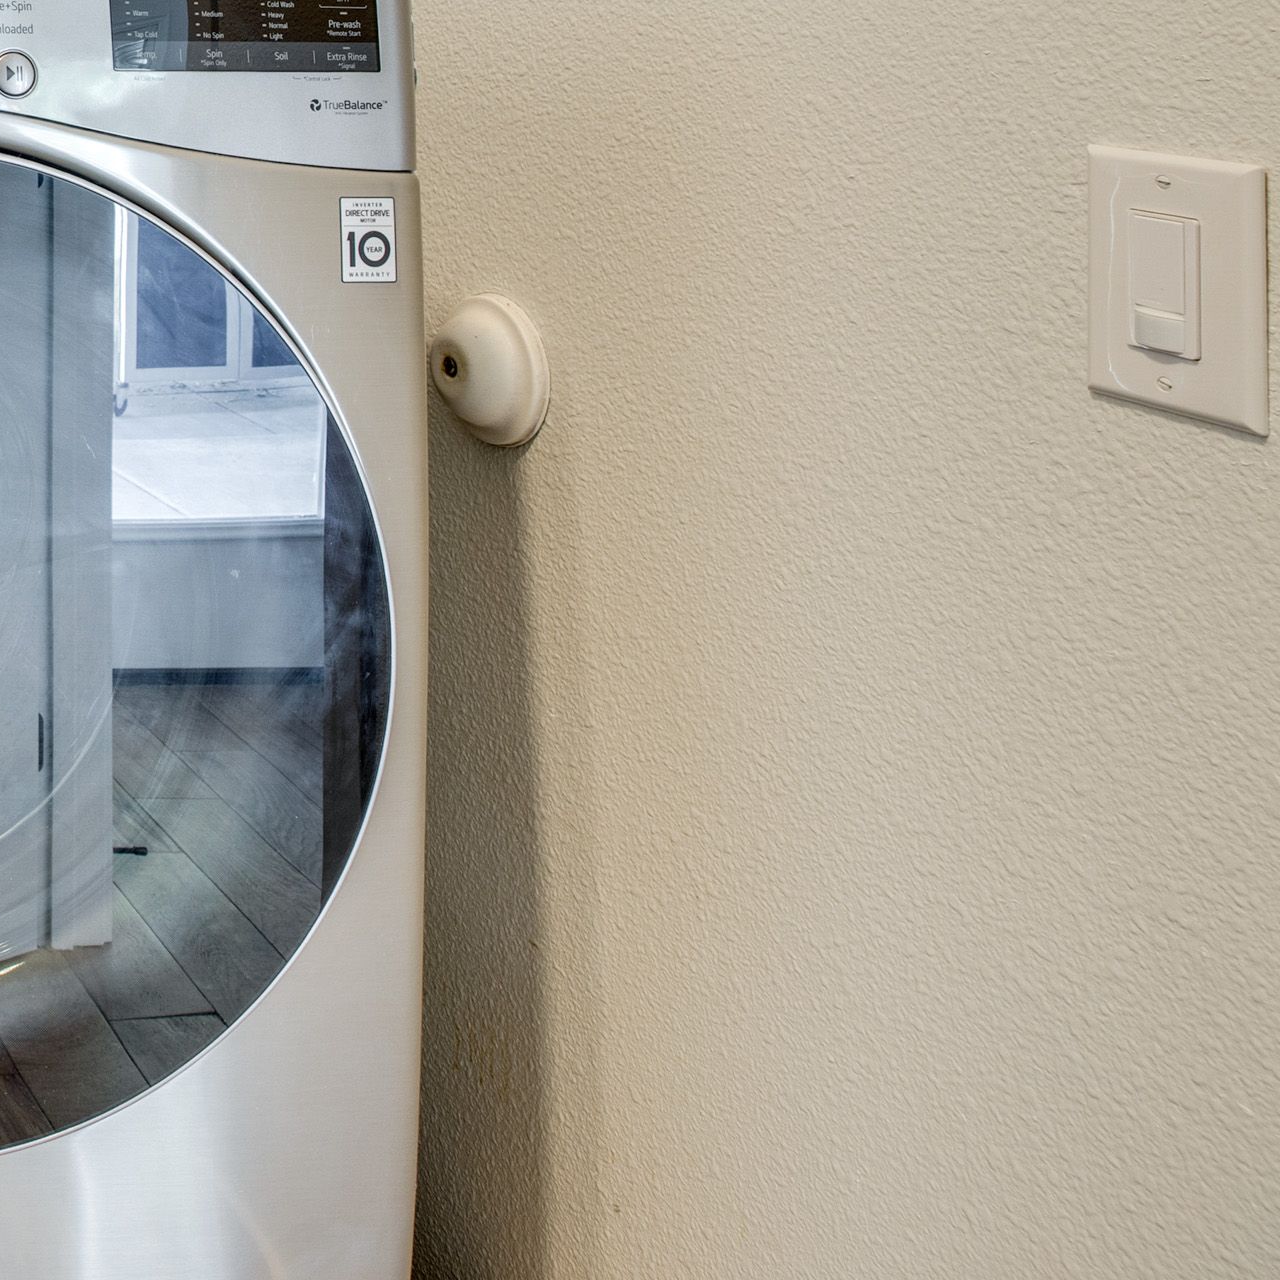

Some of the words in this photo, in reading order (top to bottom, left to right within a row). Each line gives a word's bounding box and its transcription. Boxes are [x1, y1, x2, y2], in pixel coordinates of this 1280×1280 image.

[328, 20, 361, 28] Pre-wash
[206, 49, 223, 58] Spin
[274, 52, 288, 60] Soil
[327, 52, 346, 60] Extra
[348, 53, 367, 61] Rinse
[347, 230, 391, 267] 10
